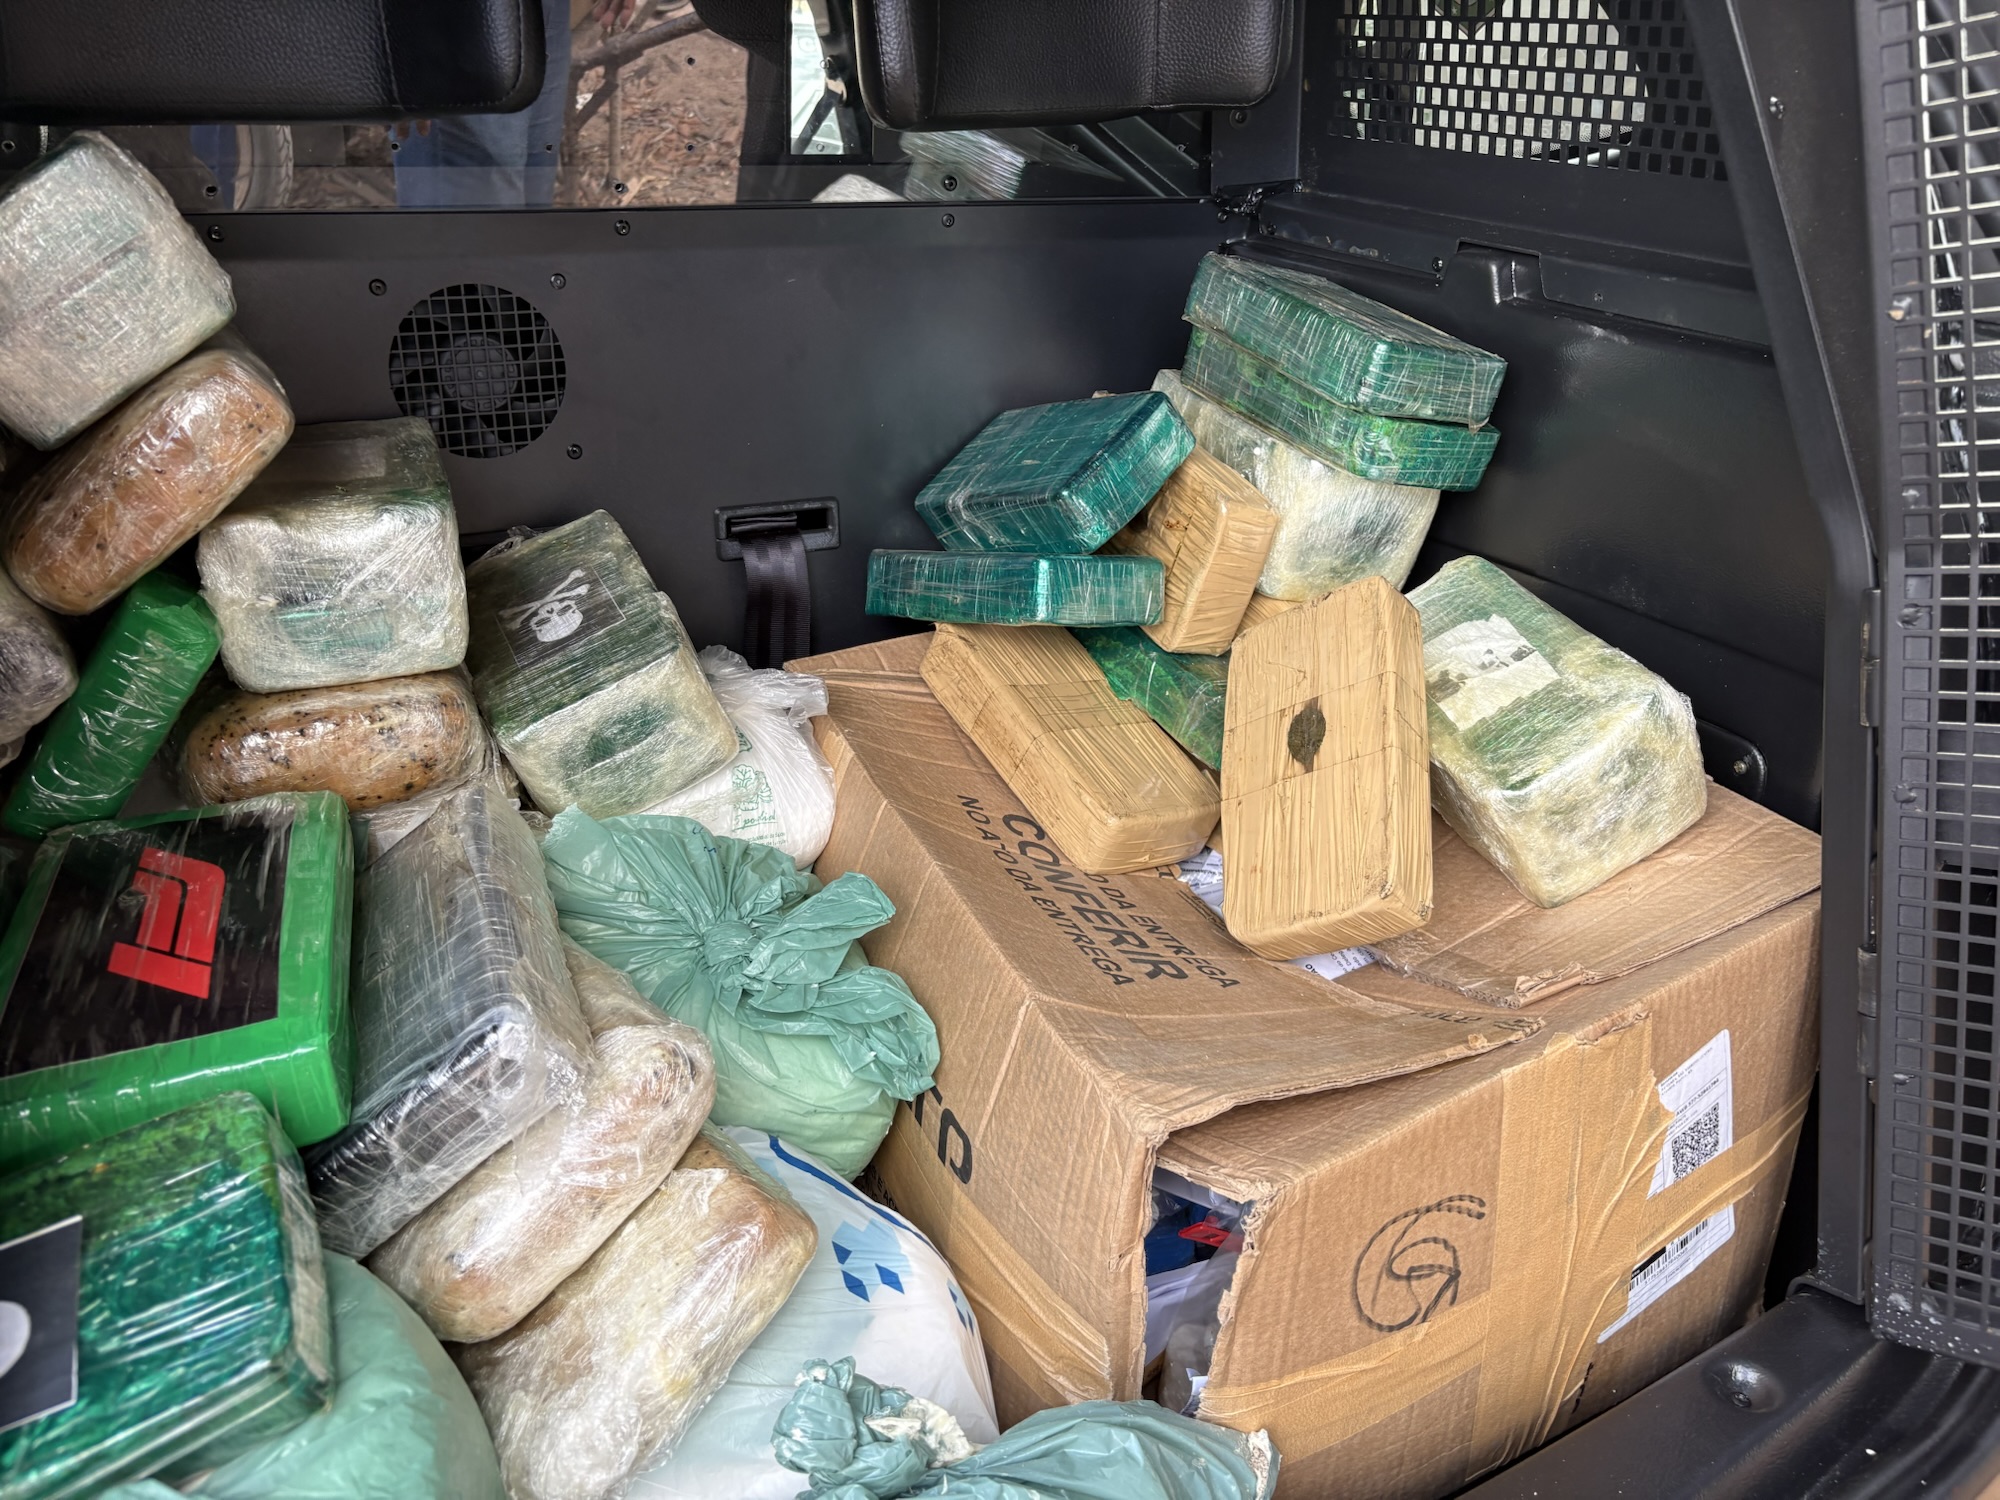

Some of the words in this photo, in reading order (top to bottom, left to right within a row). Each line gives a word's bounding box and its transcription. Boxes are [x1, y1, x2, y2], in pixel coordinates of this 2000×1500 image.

[957, 795, 991, 825] NO
[977, 827, 1018, 864] ATO
[1004, 867, 1042, 892] DA
[1031, 894, 1135, 986] ENTREGA
[1002, 814, 1188, 980] CONFERIR
[1098, 886, 1137, 911] DA
[1130, 913, 1241, 988] ENTREGA
